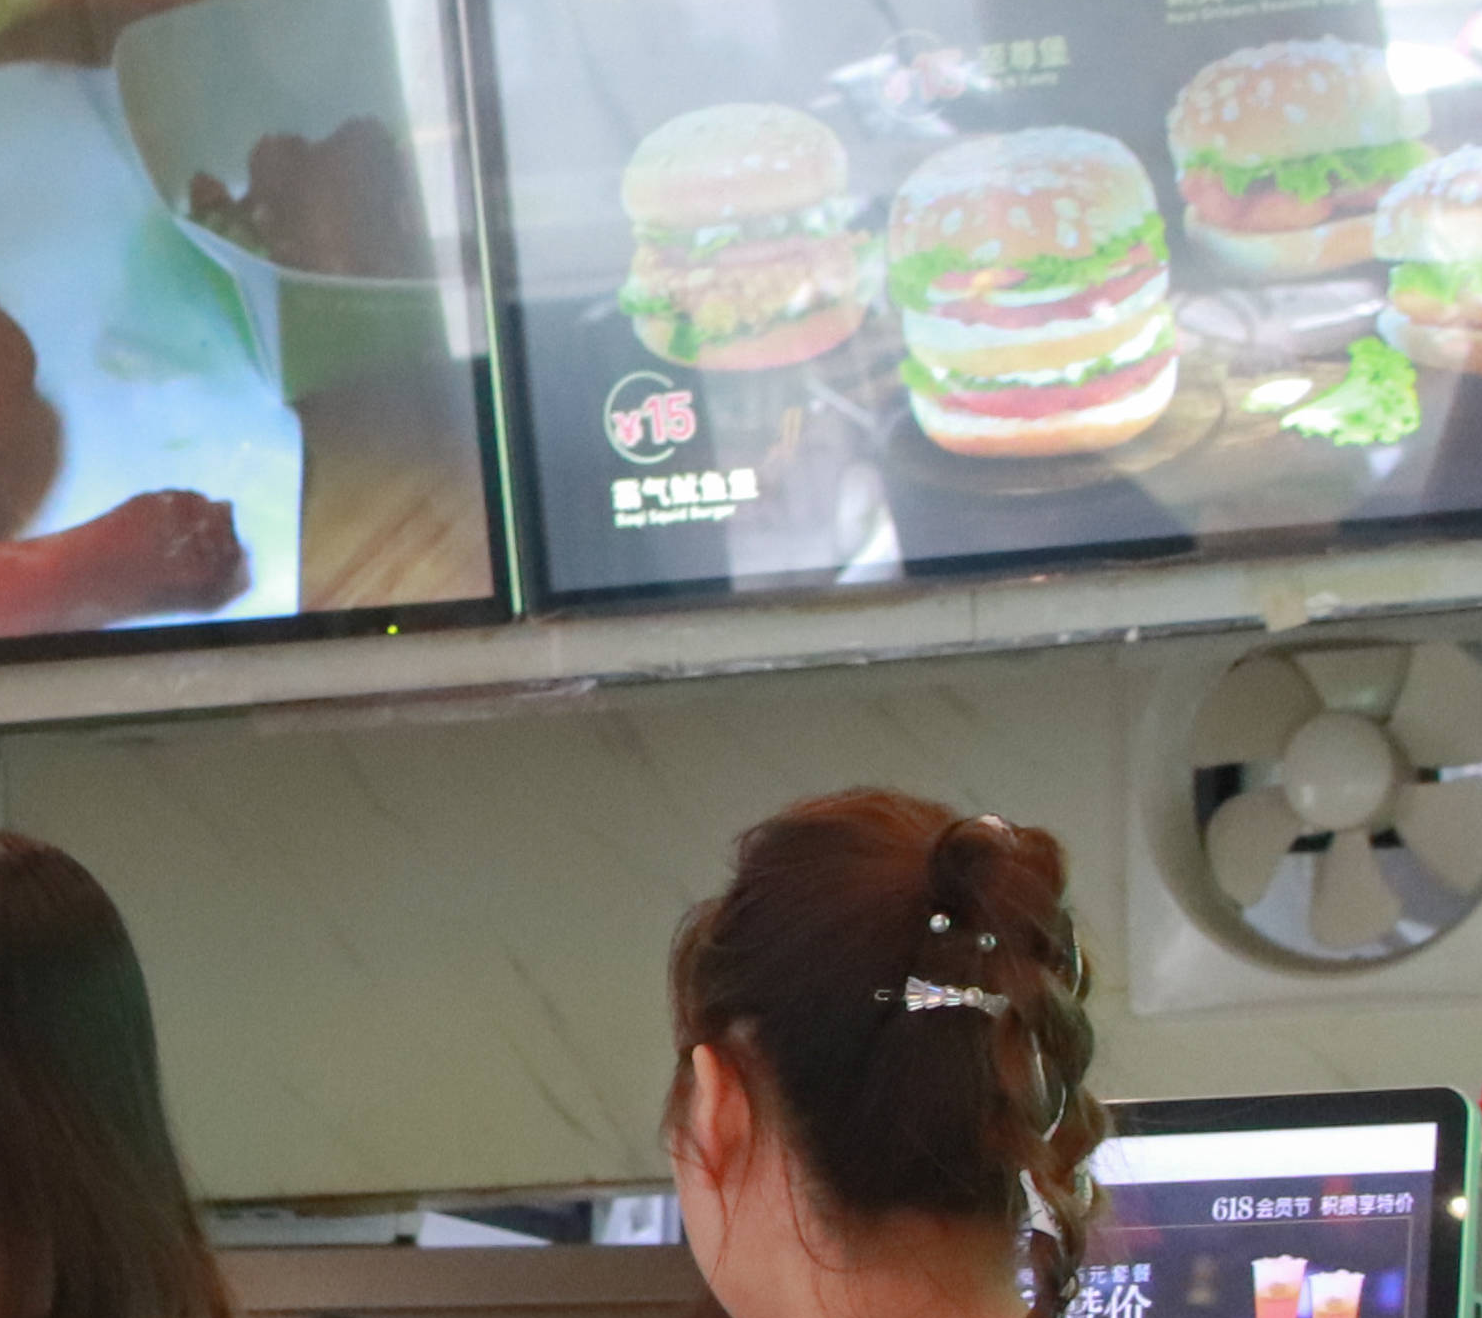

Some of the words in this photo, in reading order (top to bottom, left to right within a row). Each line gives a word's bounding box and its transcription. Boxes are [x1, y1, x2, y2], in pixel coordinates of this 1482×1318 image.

[611, 389, 696, 447] ¥15
[1211, 1195, 1313, 1222] 618会员节
